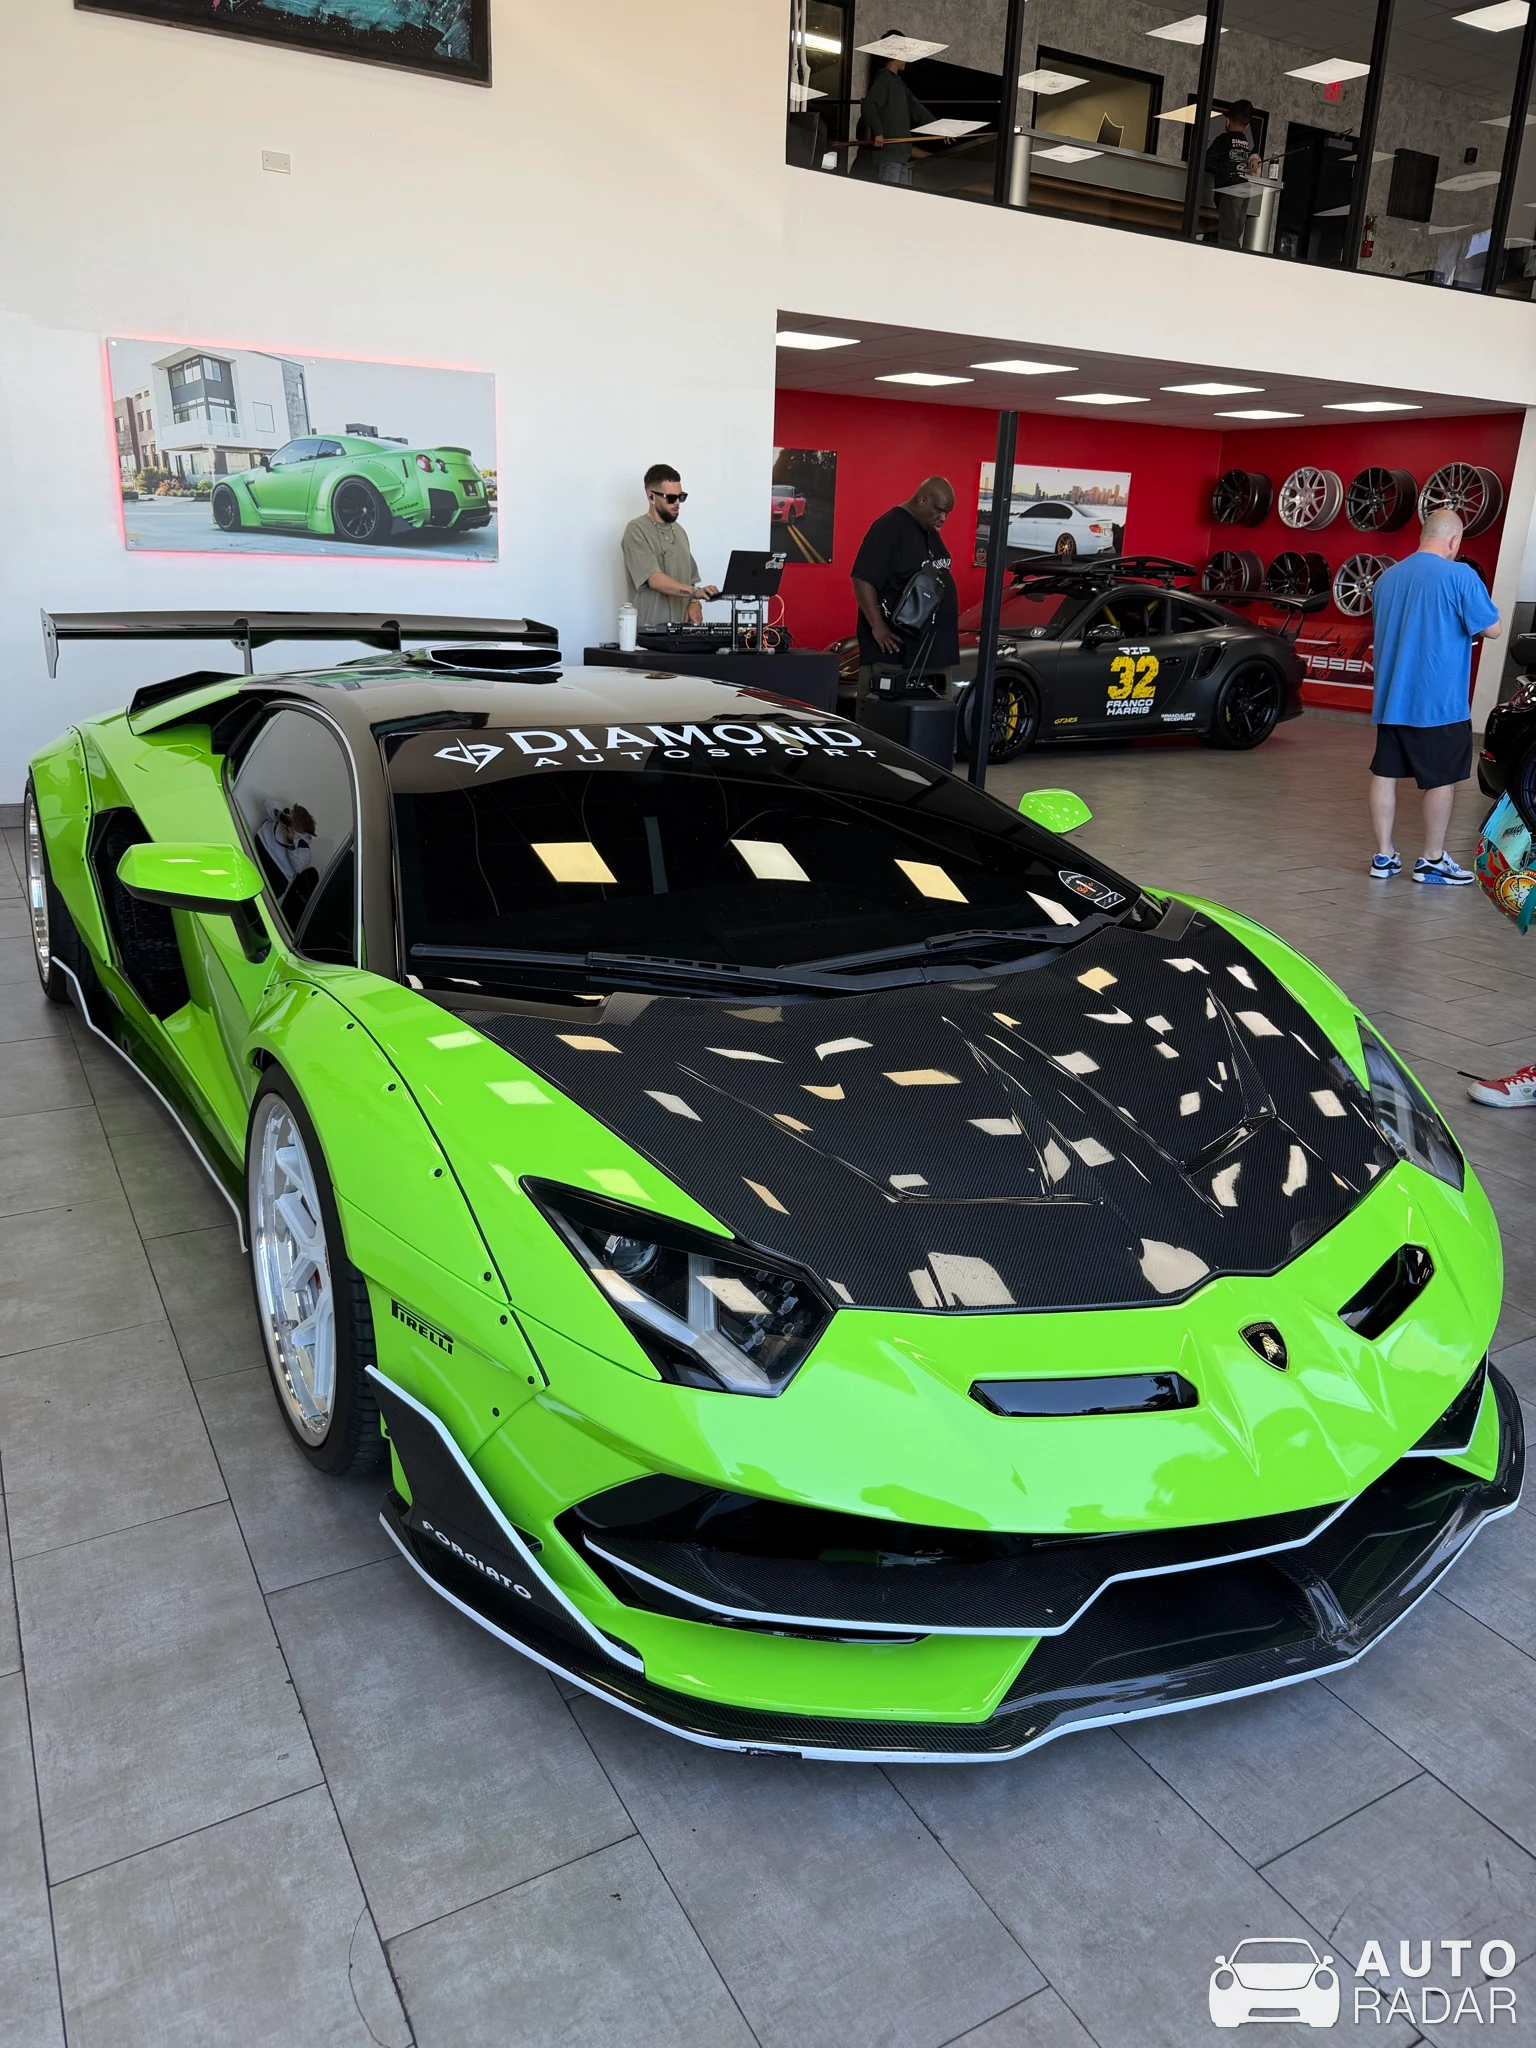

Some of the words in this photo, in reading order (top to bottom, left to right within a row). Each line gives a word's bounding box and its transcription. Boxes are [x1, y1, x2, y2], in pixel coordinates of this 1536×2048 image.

[1118, 646, 1151, 655] RIP
[1107, 655, 1160, 700] 32
[1106, 699, 1154, 708] FRANCO
[1106, 706, 1150, 716] HARRIS
[505, 724, 863, 755] DIAMOND
[533, 748, 878, 768] AUTOSPORT
[390, 1297, 454, 1356] PIRELLI
